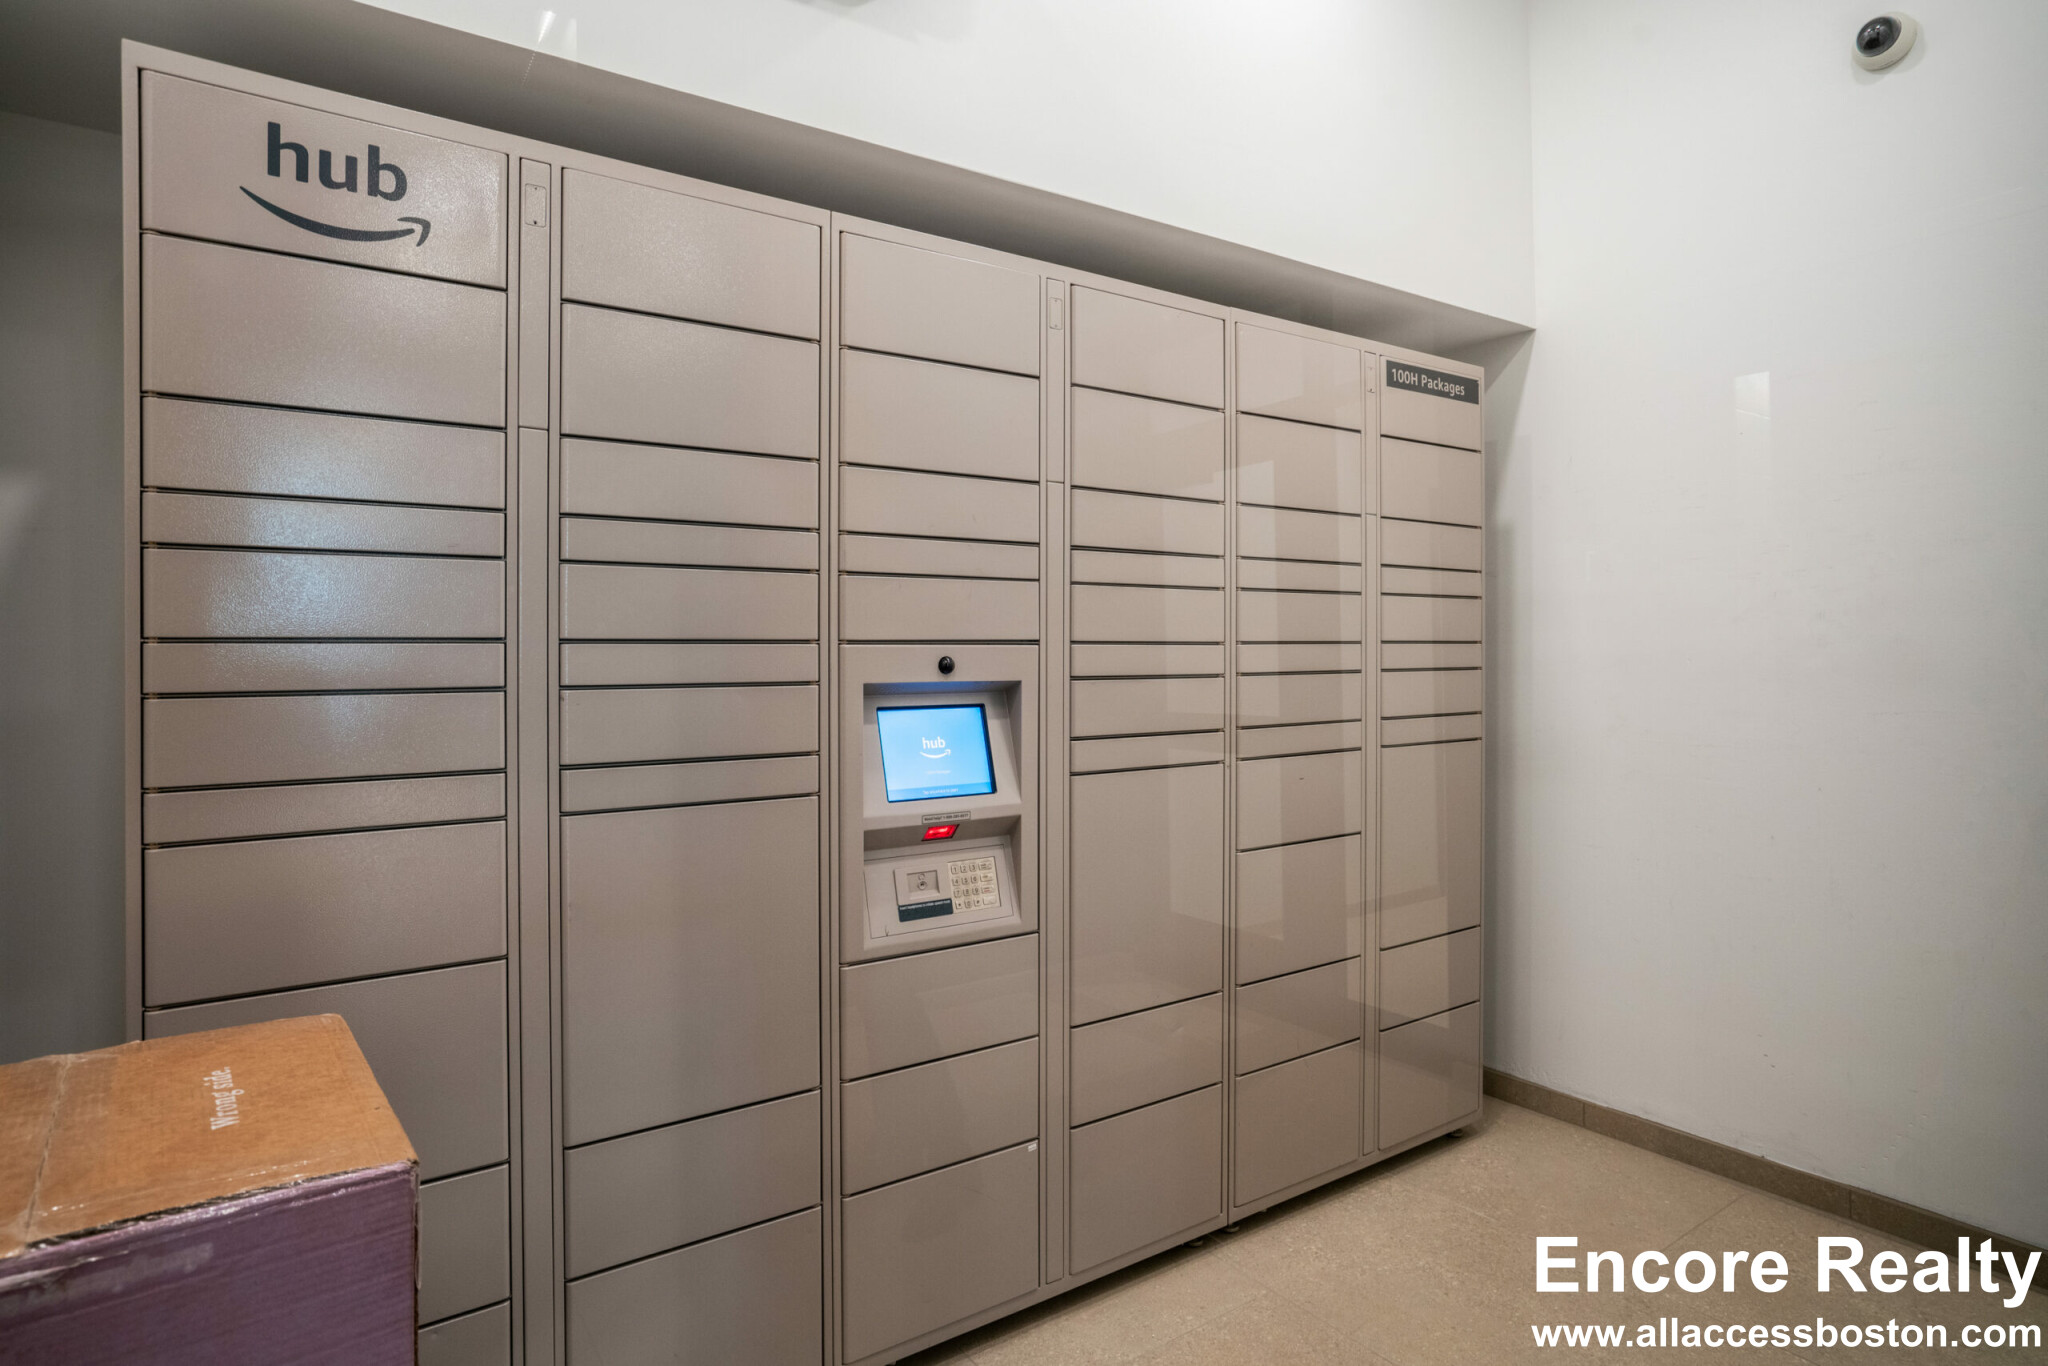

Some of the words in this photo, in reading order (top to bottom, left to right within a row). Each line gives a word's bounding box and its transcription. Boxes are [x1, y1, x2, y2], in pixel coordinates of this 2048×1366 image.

[267, 121, 407, 201] hub
[1391, 368, 1418, 386] 100H
[1421, 374, 1465, 396] Packages
[922, 736, 946, 750] hub
[203, 1066, 233, 1089] side.
[210, 1089, 245, 1130] Wrong
